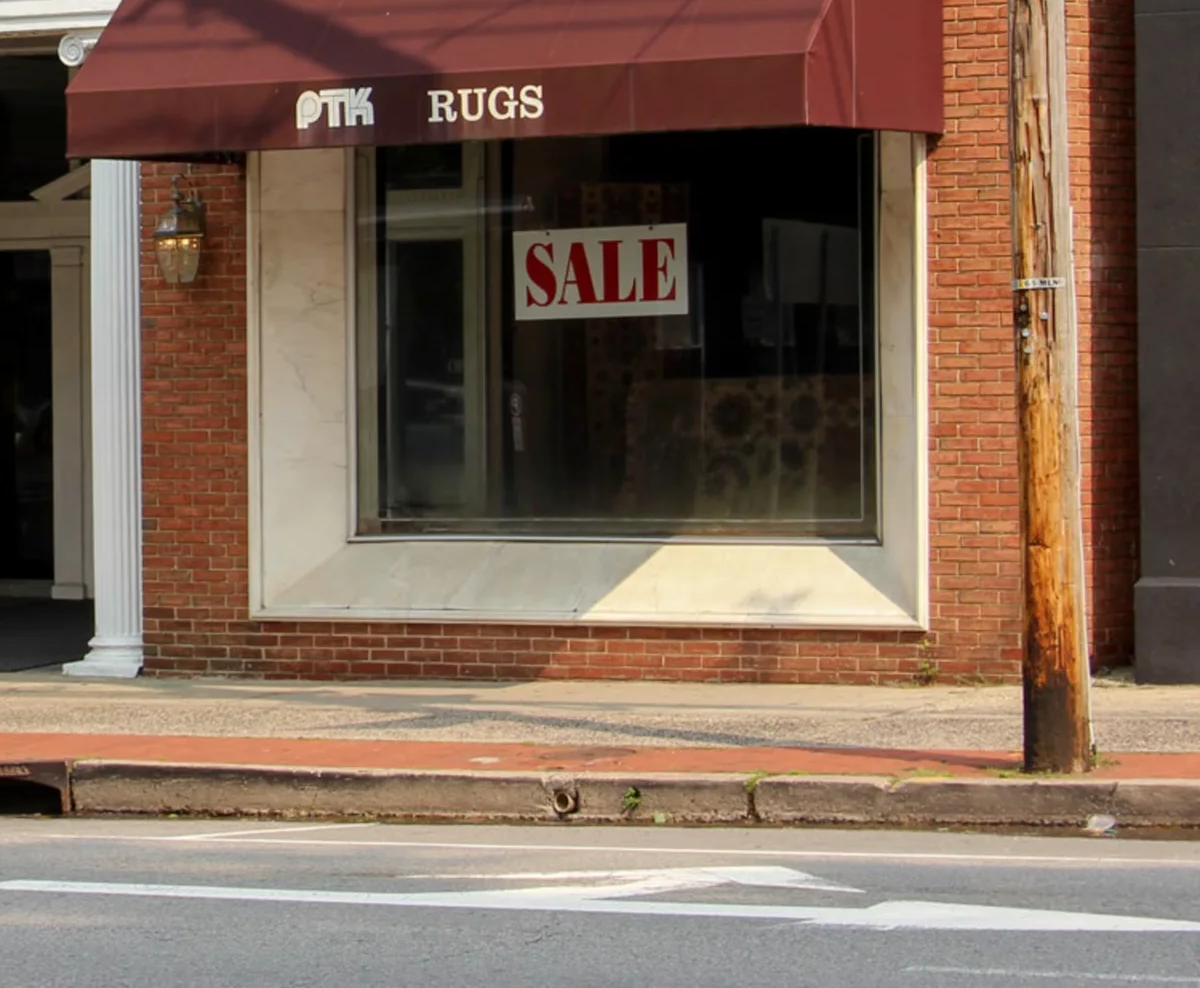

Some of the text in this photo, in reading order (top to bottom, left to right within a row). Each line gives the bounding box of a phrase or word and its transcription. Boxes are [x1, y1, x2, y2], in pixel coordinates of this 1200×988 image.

[296, 84, 545, 129] PTK RUGS
[525, 237, 677, 308] SALE
